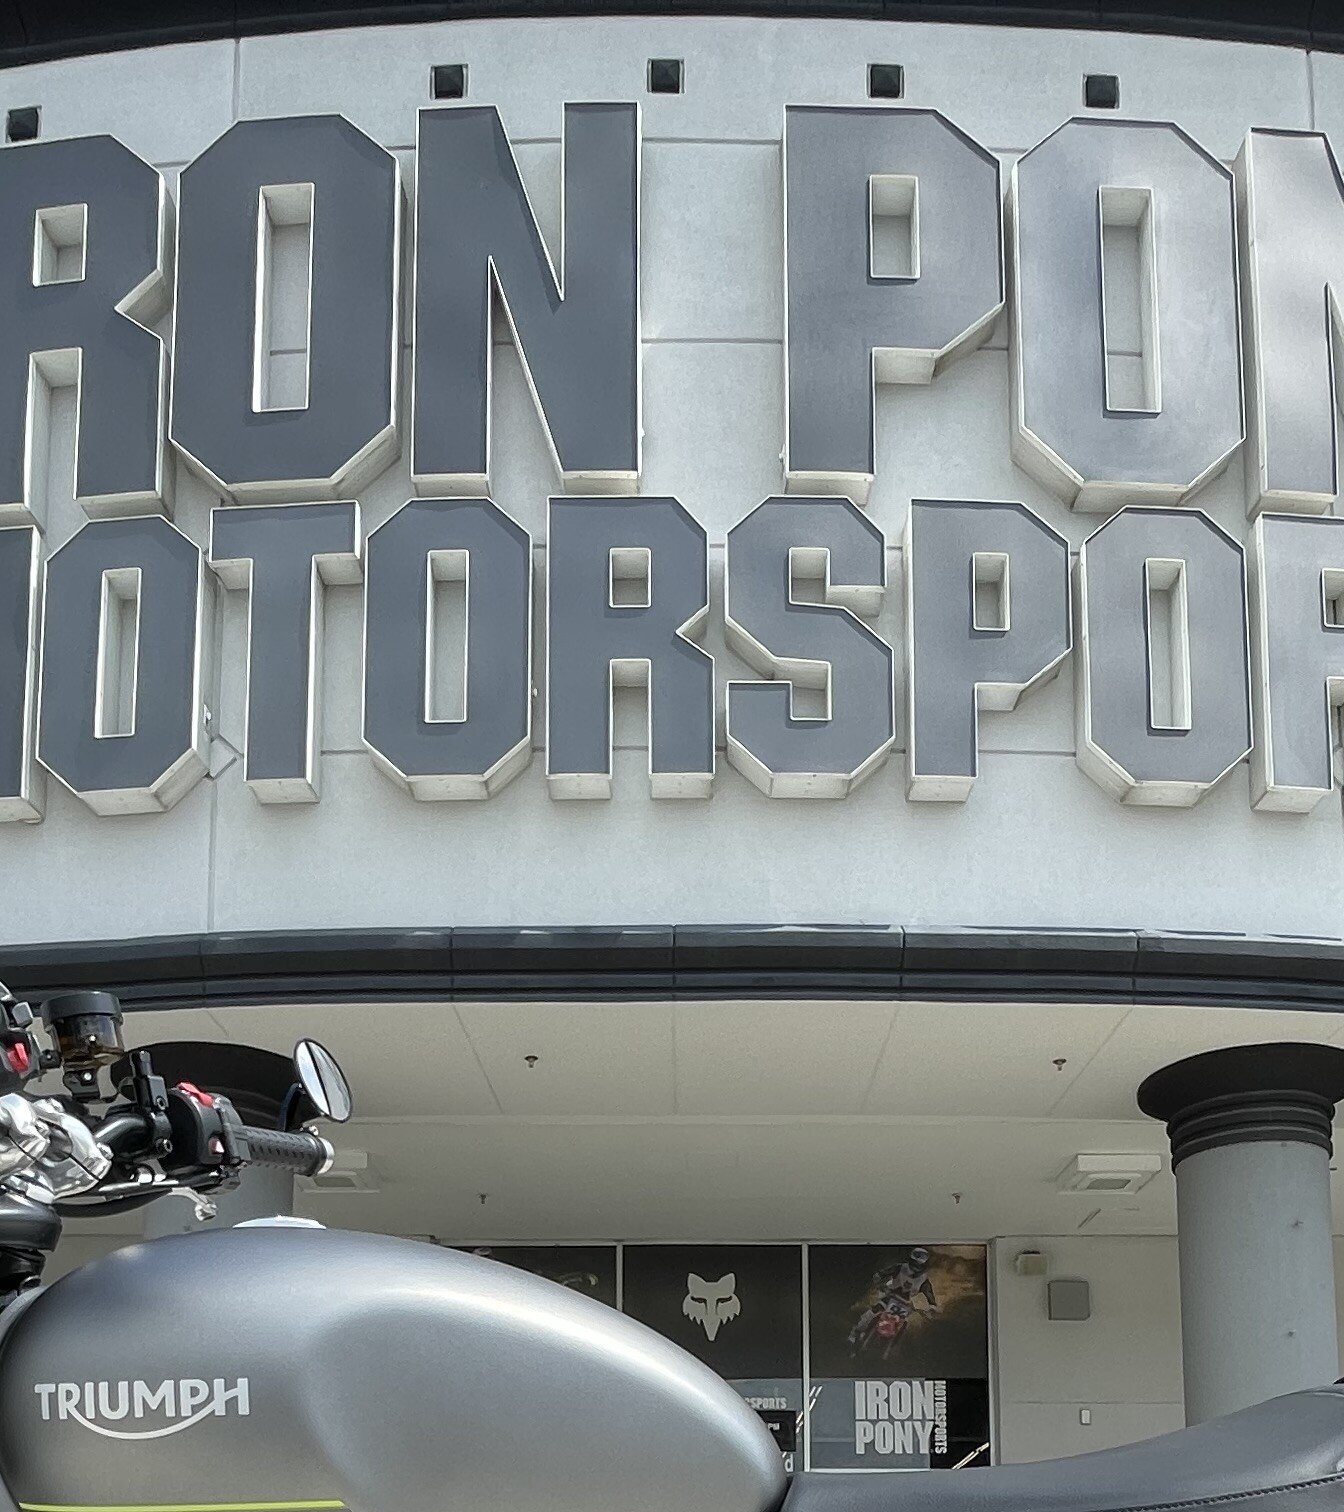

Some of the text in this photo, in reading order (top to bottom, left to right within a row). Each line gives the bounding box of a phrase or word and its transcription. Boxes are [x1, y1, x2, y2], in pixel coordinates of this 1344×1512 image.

[34, 1377, 250, 1440] TRIUMPH
[855, 1380, 935, 1420] IRON
[934, 1380, 948, 1455] MOTORSPORTS
[855, 1421, 934, 1455] PONY
